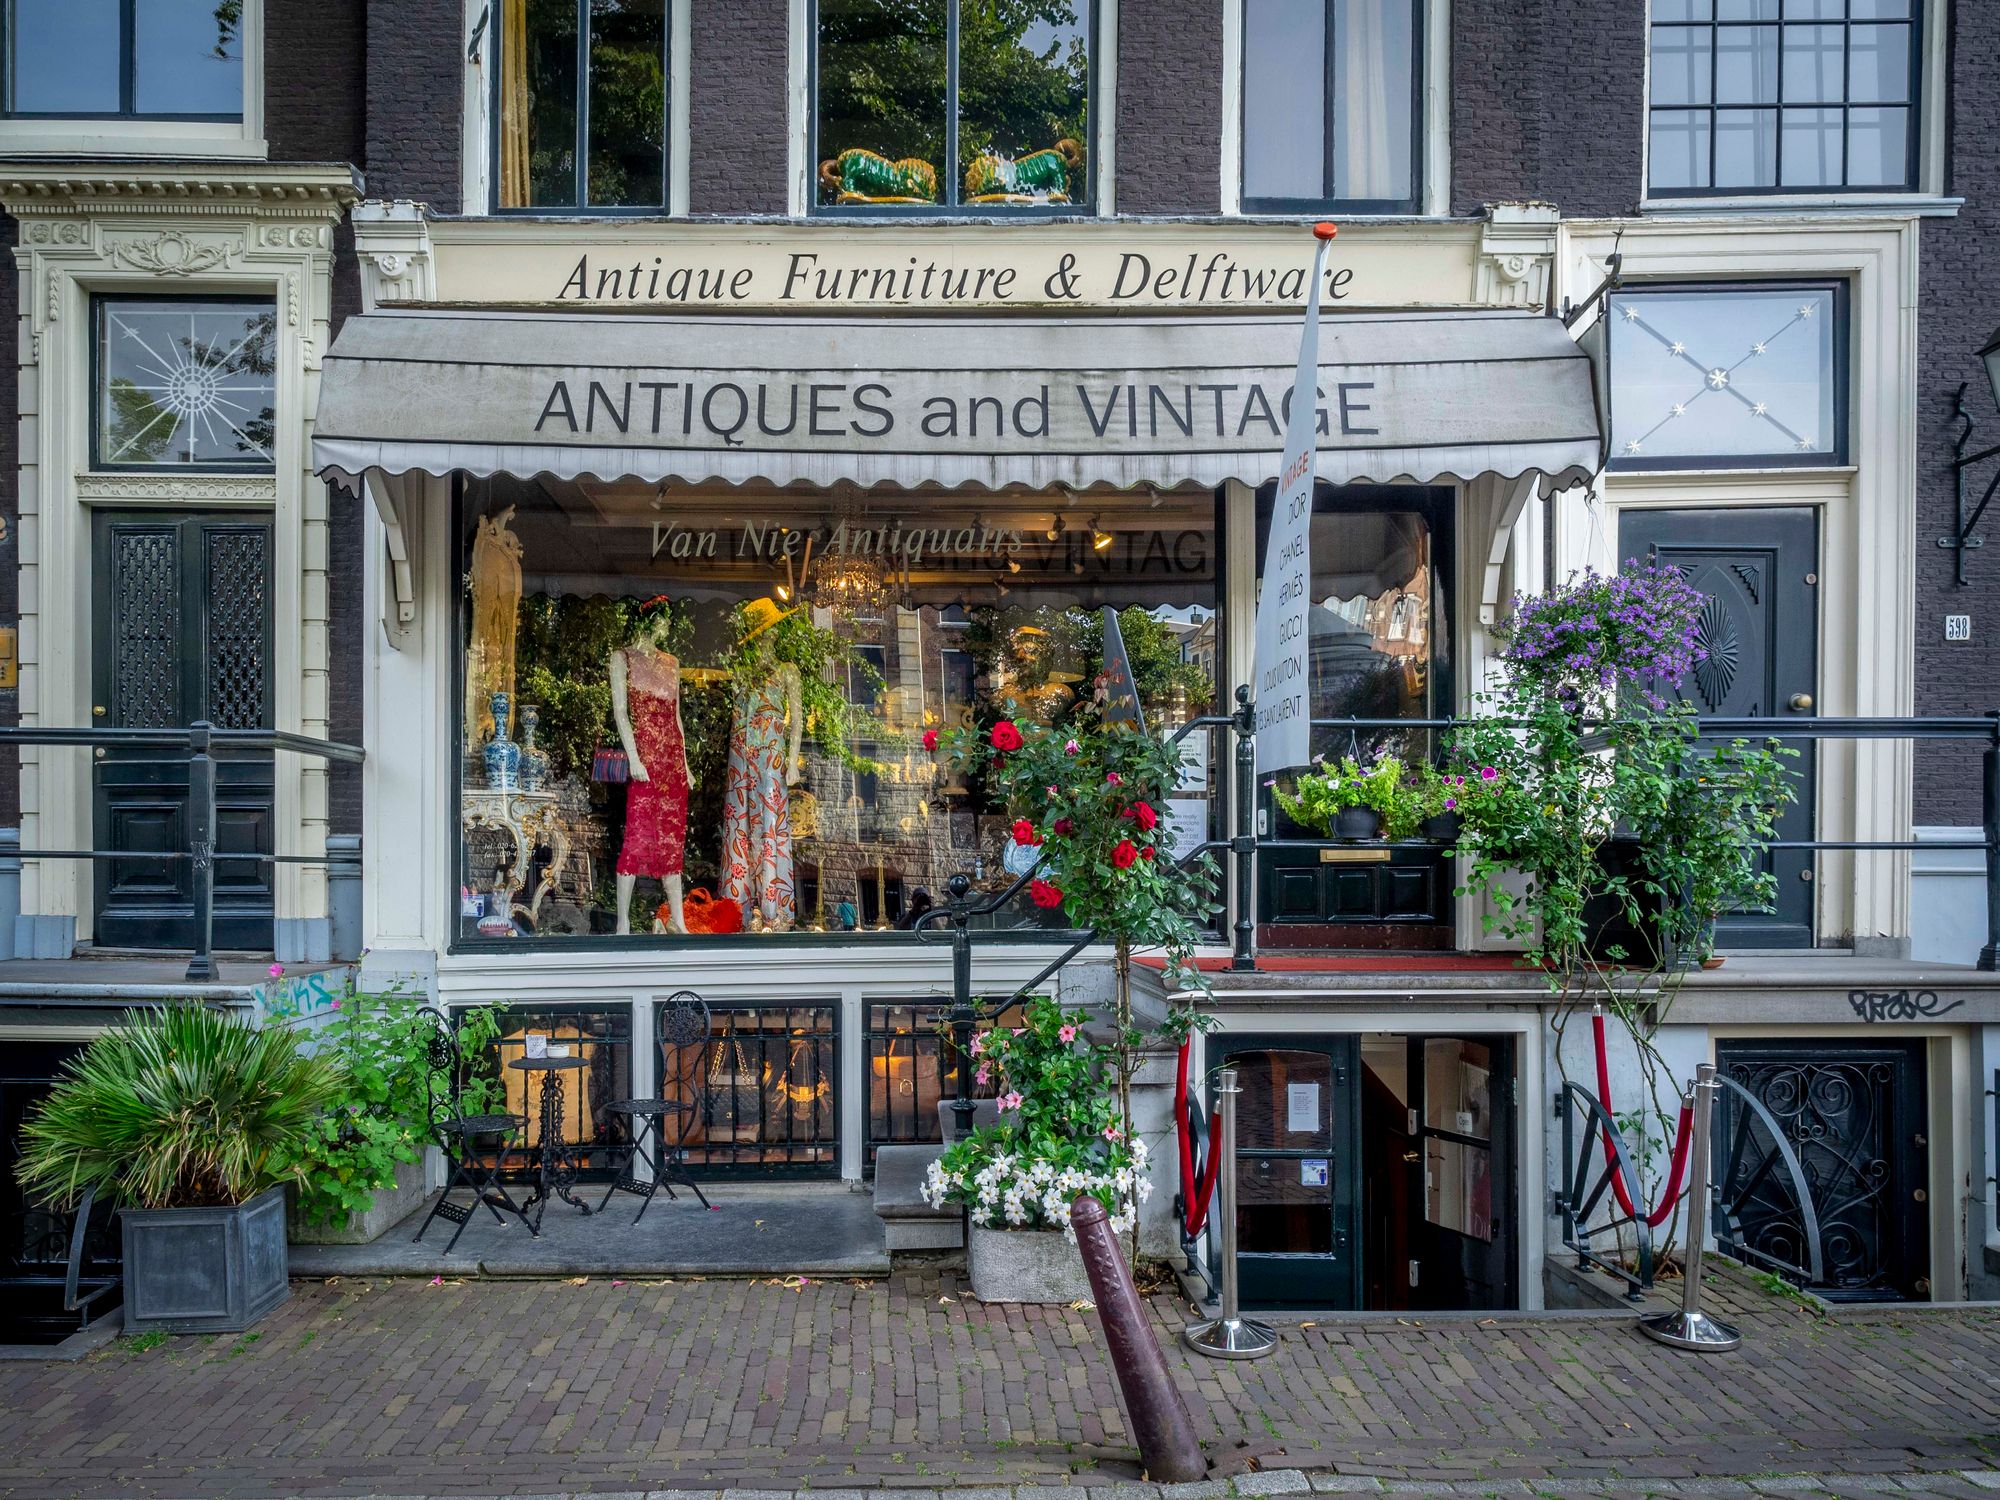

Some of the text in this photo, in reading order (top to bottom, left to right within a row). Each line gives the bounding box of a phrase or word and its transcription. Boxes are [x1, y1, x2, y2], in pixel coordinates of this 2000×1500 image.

[555, 253, 755, 302] Antique
[777, 253, 1018, 301] Furniture
[1043, 253, 1083, 300] &
[533, 380, 896, 447] ANTIQUES
[919, 384, 1050, 438] and
[1287, 492, 1307, 525] DIOR
[649, 519, 718, 558] Van
[736, 519, 801, 558] Nie
[823, 518, 1026, 563] Antiquairs
[1279, 533, 1305, 571] CHANEL
[1278, 571, 1304, 609] HERMÈS
[1279, 614, 1303, 645] GUCCI
[1948, 617, 1968, 639] 598
